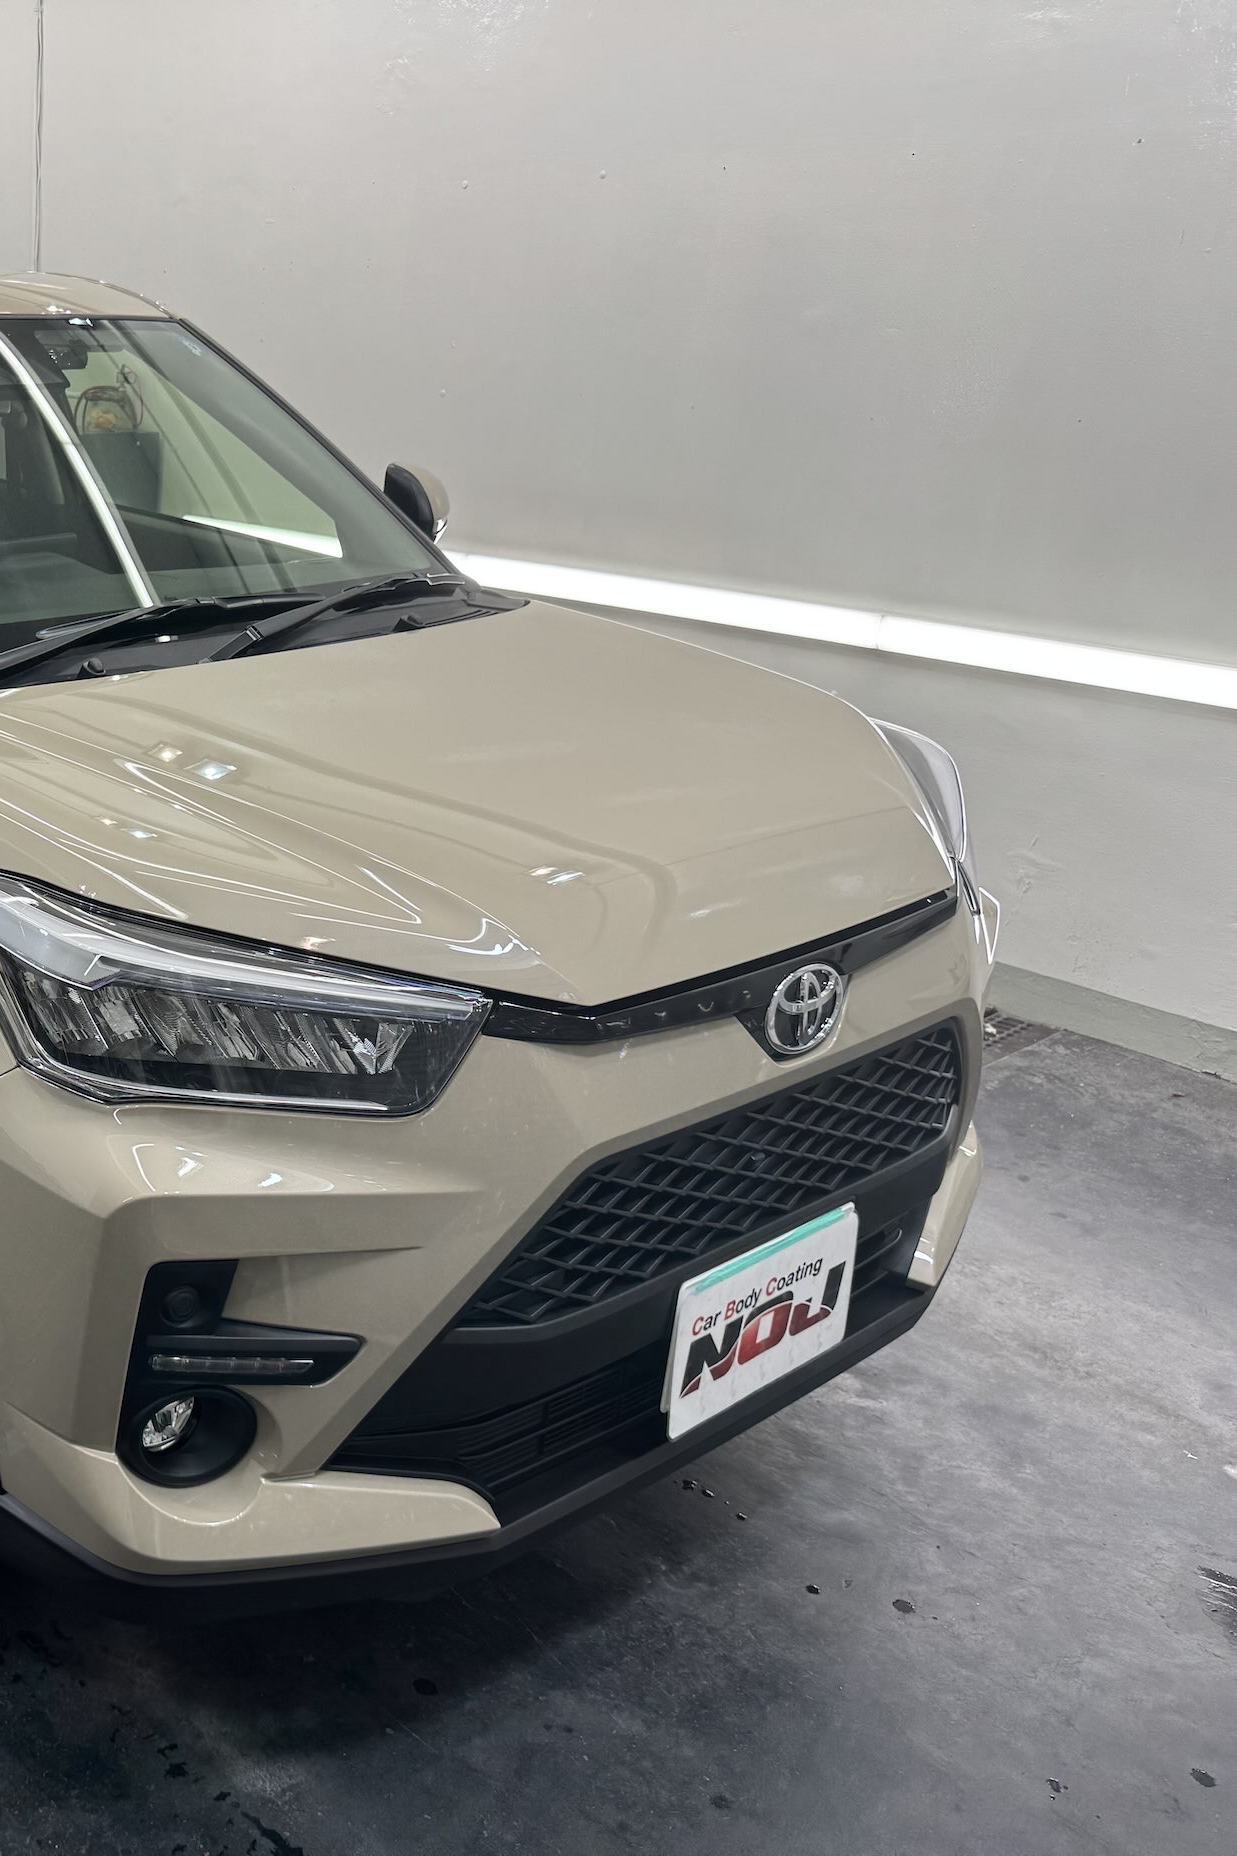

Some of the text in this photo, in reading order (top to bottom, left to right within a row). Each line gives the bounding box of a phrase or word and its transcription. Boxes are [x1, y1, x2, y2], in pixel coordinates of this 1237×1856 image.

[692, 1258, 823, 1336] Car Body Coating
